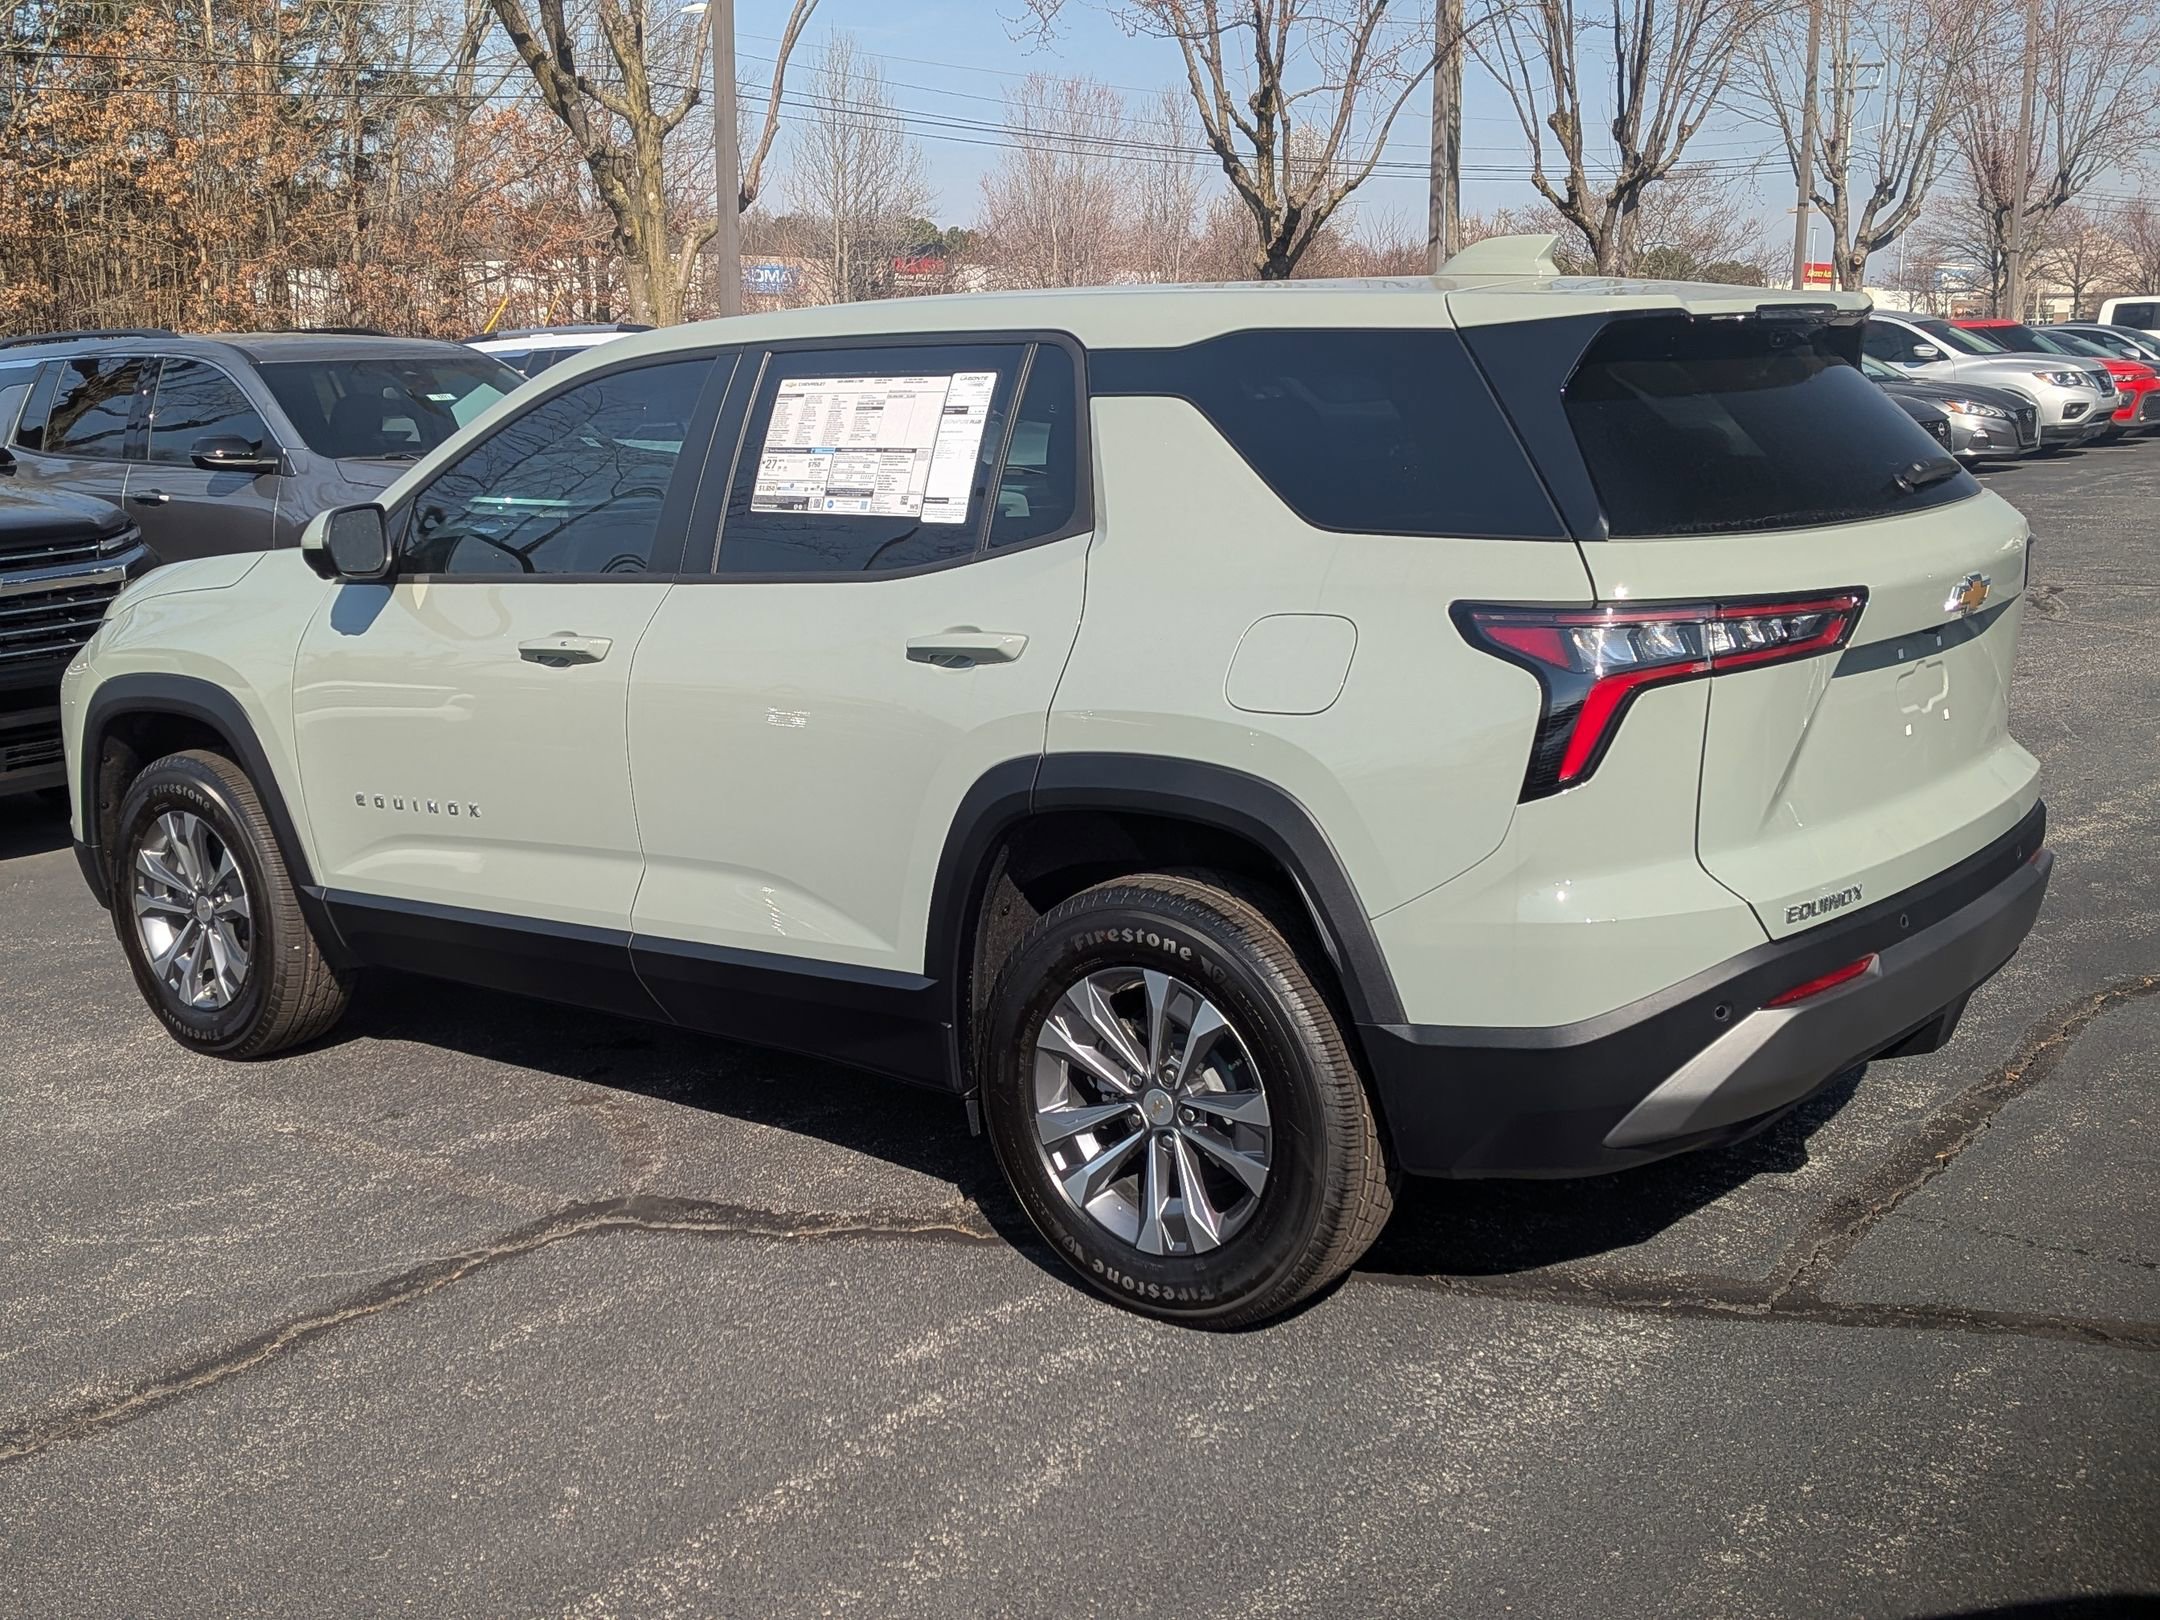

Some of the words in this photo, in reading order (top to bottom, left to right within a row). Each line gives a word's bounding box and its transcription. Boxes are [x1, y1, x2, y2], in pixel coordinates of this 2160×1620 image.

[765, 459, 777, 469] 27
[152, 783, 211, 810] Firestone
[355, 793, 481, 818] EQUINOX
[1785, 883, 1863, 925] EQUINOX
[1070, 927, 1193, 961] Firestone
[1091, 1258, 1215, 1301] Firestone
